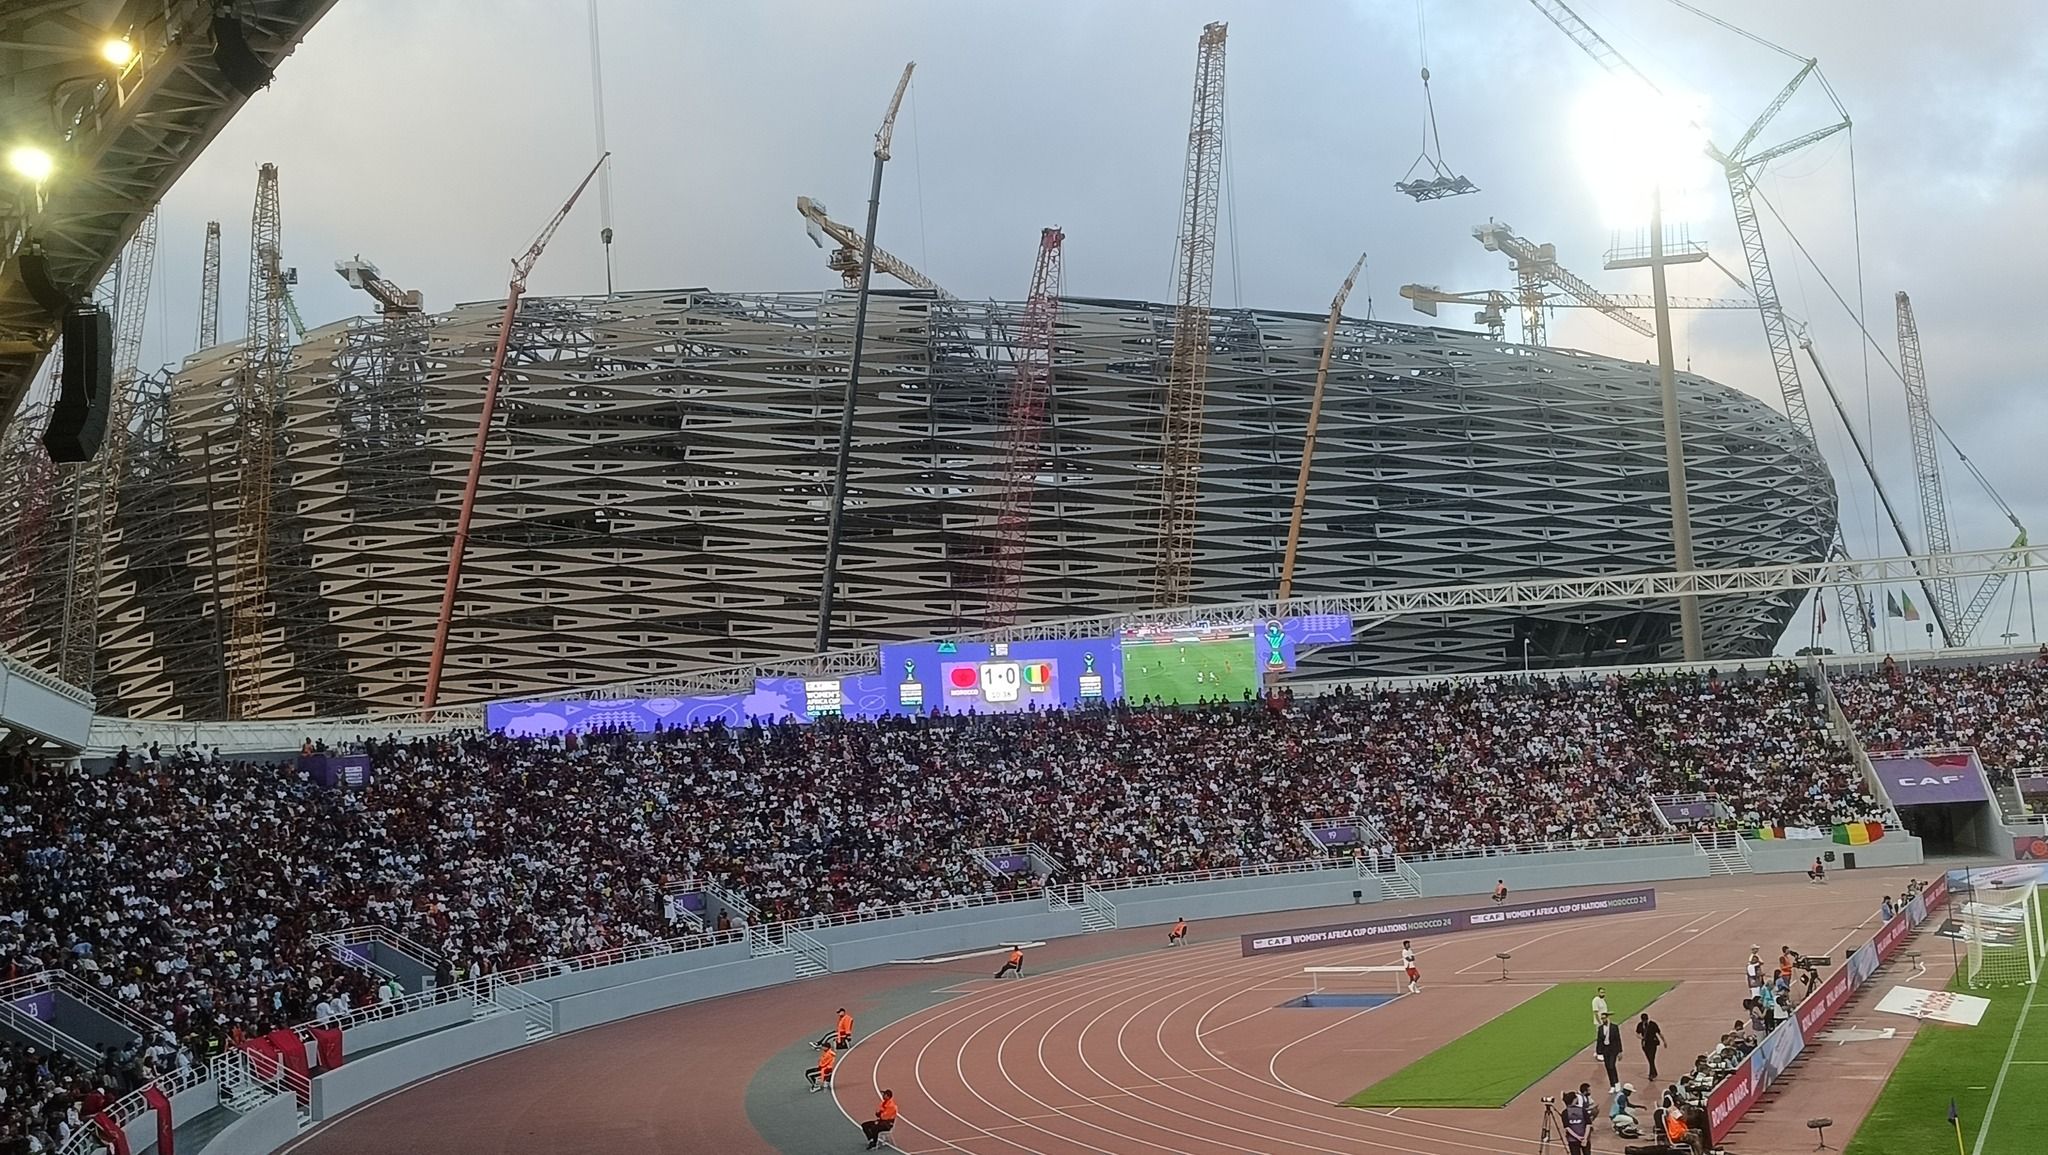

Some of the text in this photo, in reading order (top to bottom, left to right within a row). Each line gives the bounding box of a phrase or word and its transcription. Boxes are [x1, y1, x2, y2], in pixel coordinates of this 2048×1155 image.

[985, 667, 1015, 684] 1 0
[1898, 775, 1962, 786] CAF
[999, 860, 1010, 869] 20
[1483, 913, 1500, 921] CAF
[1505, 909, 1536, 919] WOMEN'S
[1536, 906, 1559, 916] AFRICA
[1559, 904, 1571, 913] CUP
[1571, 903, 1580, 912] OF
[1581, 900, 1608, 911] NATIONS
[1608, 897, 1639, 907] MOROCCO
[1267, 937, 1288, 945] CAF
[1292, 932, 1327, 943] WOMEN'S
[1328, 929, 1352, 939] AFRICA
[1353, 927, 1367, 937] CUP
[1367, 926, 1377, 935] OF
[1377, 923, 1407, 934] NATIONS
[1407, 919, 1442, 930] MOROCCO
[28, 1002, 38, 1017] 23
